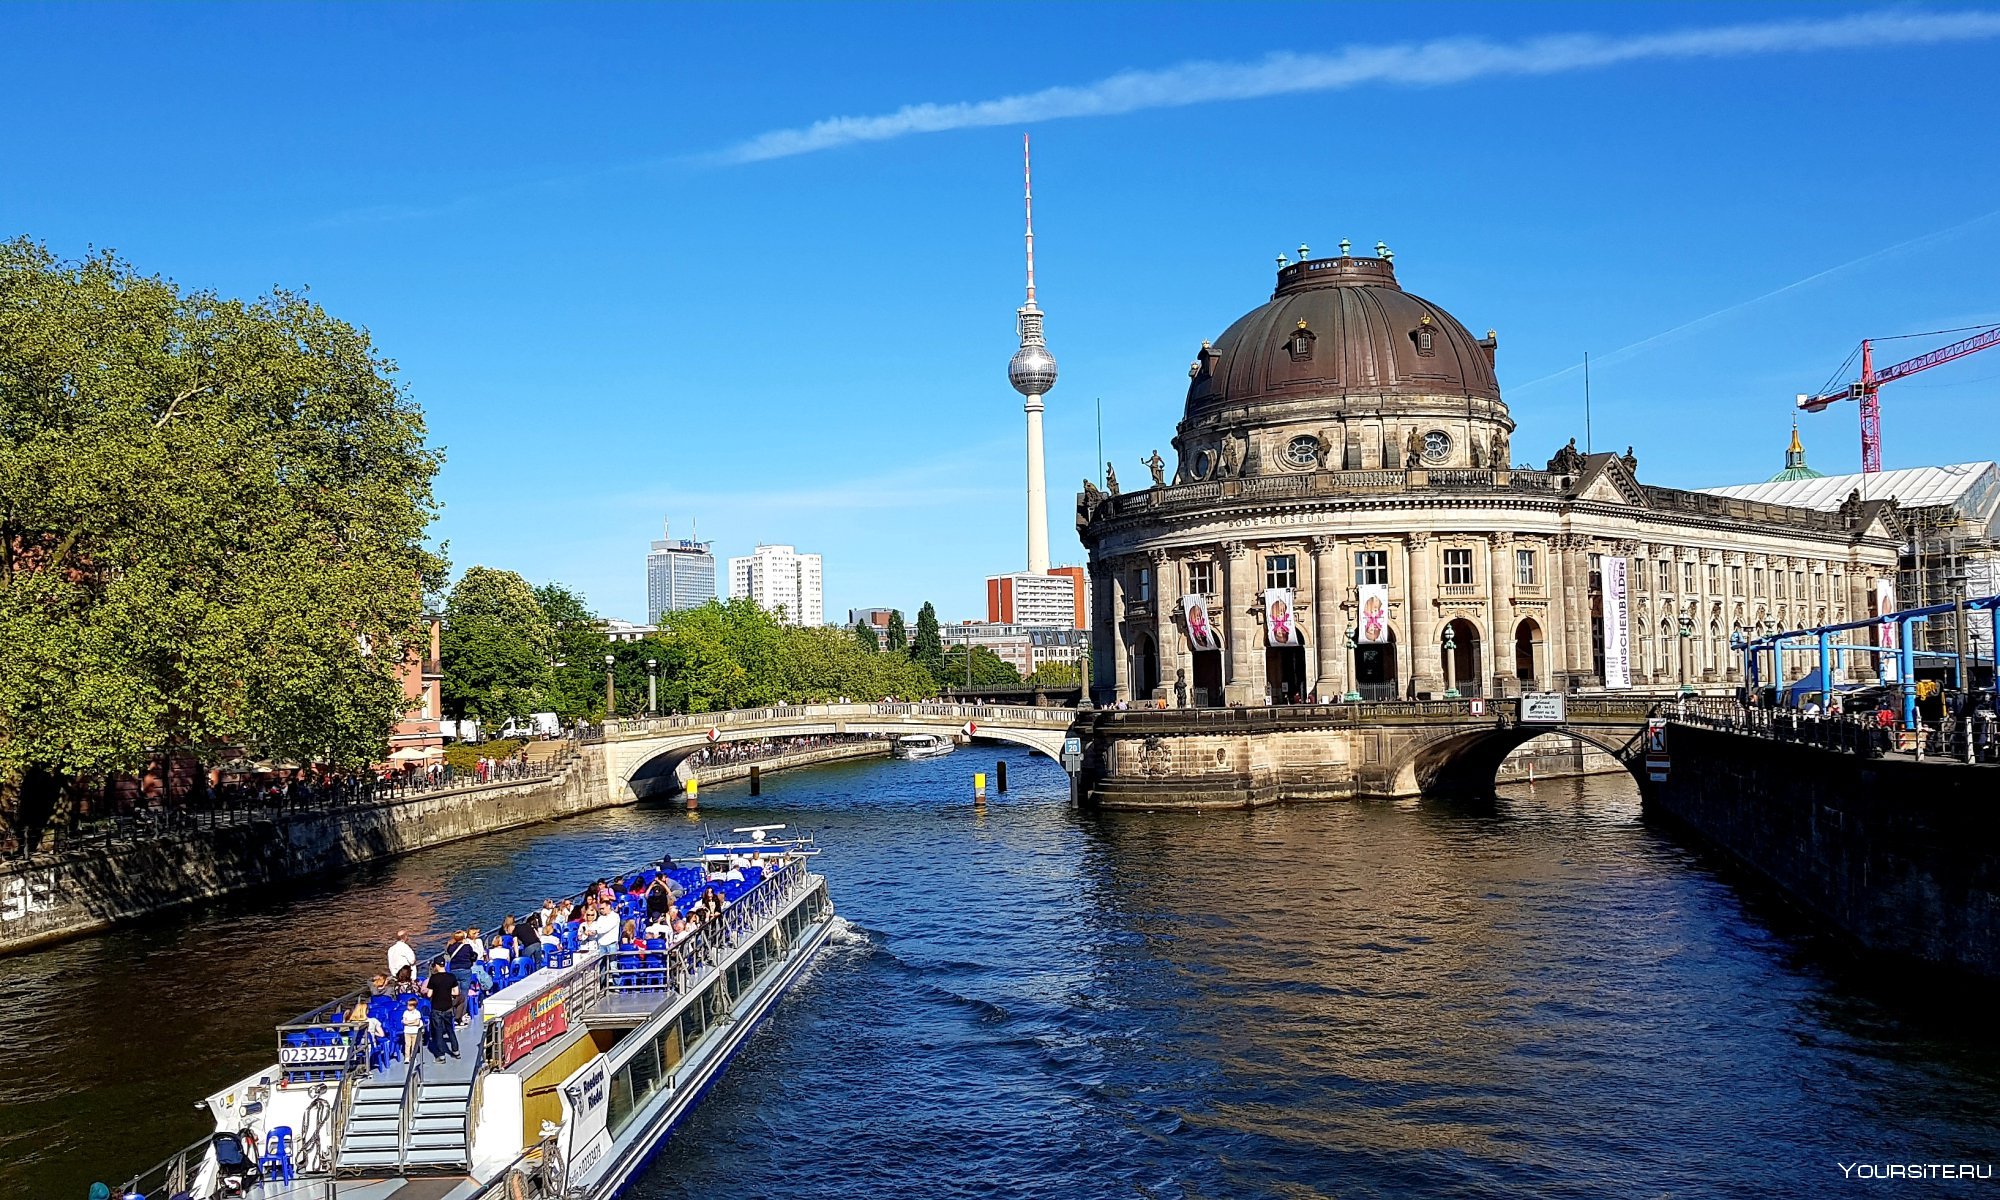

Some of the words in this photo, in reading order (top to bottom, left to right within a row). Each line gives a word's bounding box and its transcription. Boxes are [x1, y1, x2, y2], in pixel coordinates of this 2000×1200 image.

[1228, 515, 1325, 528] BODE-MUSEUM
[1618, 561, 1630, 685] MENSCHENBILDER
[1068, 744, 1078, 752] 20
